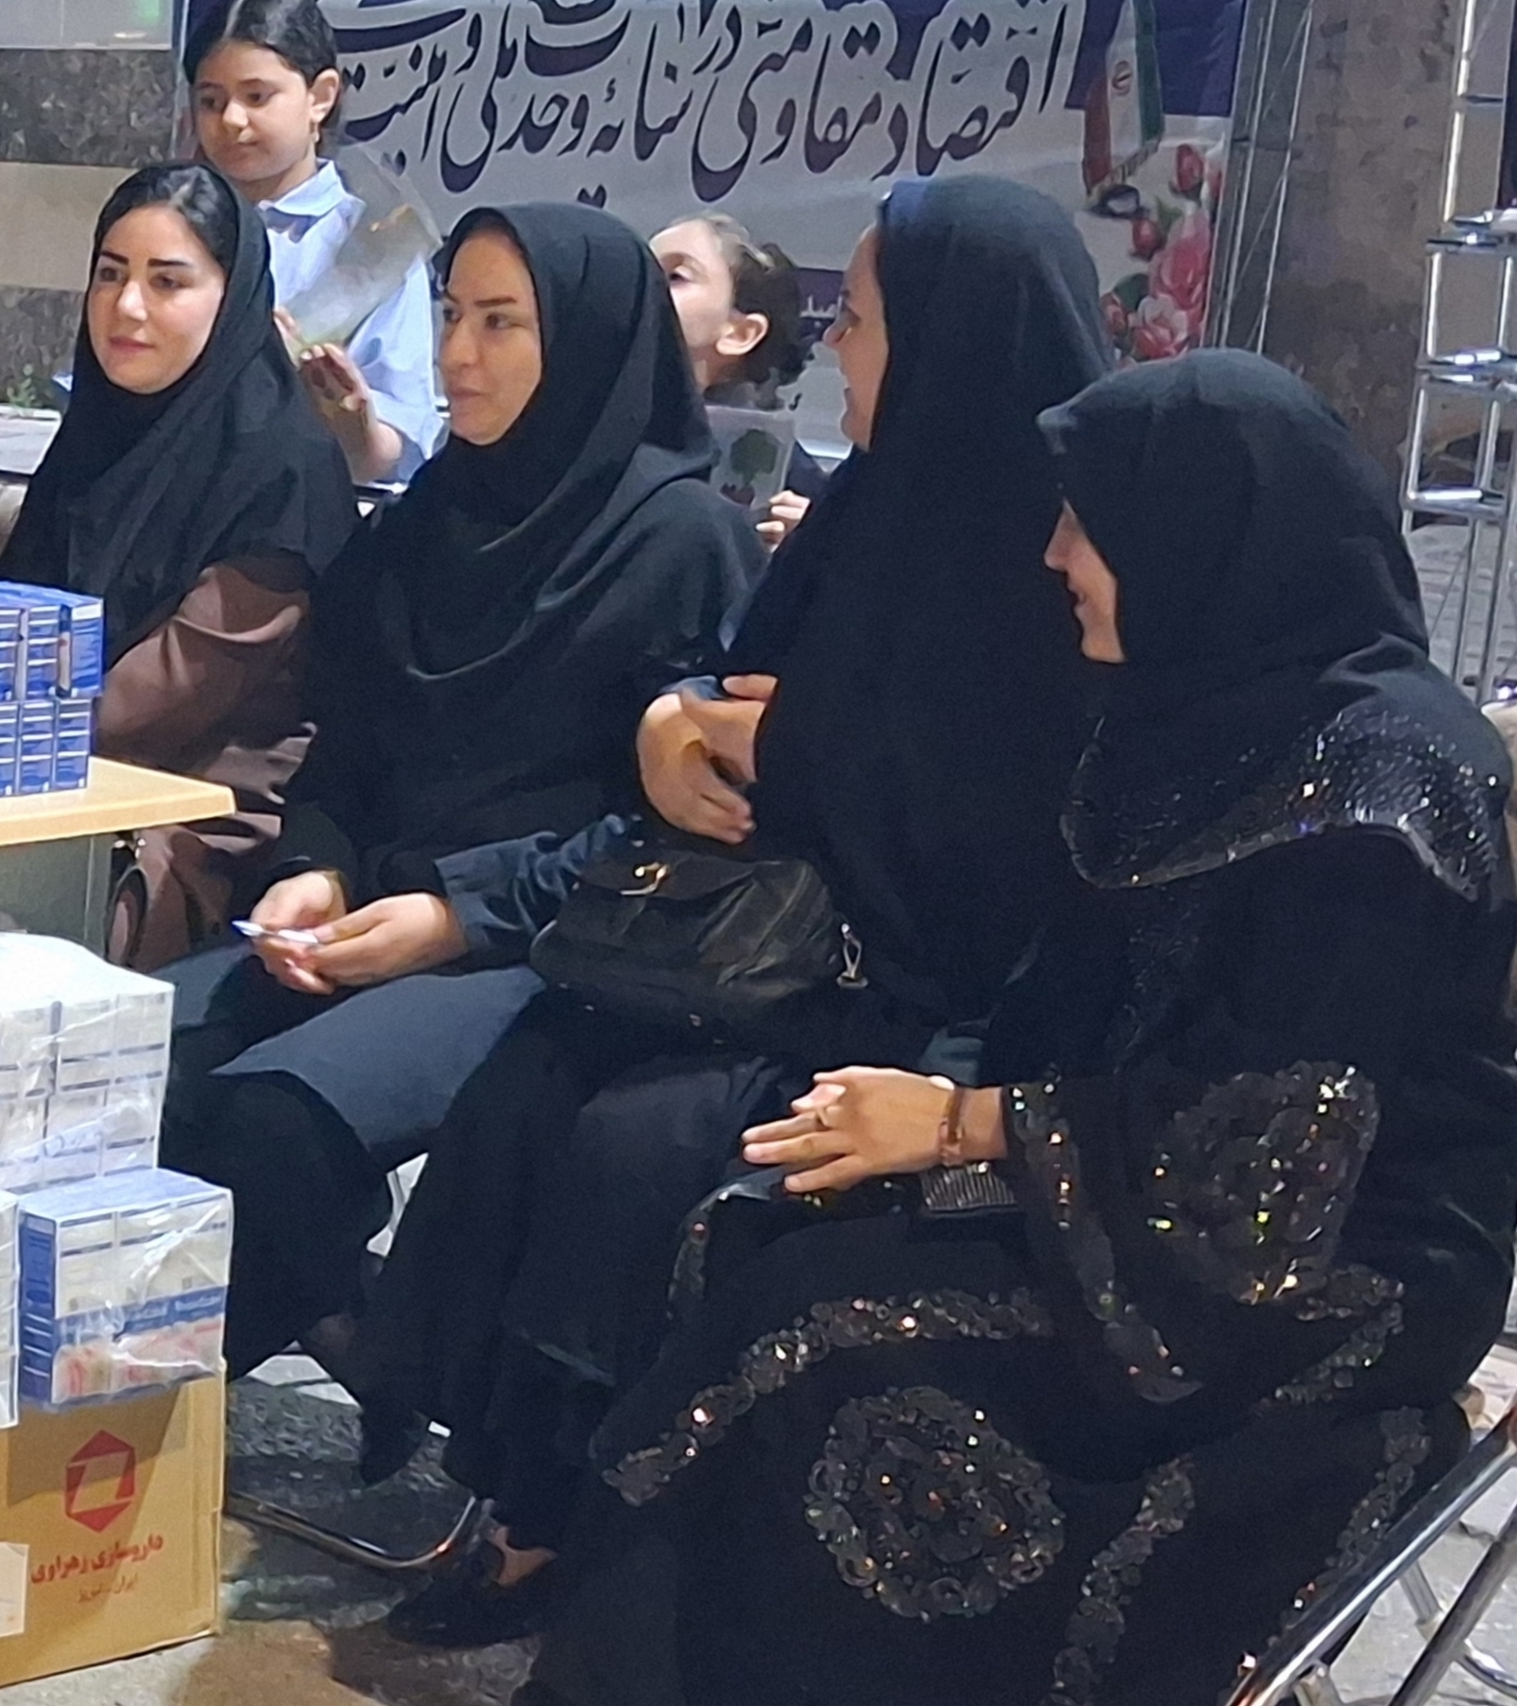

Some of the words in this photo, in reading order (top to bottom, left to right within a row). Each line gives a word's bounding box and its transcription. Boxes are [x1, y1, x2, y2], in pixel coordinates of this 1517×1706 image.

[691, 17, 881, 204] مقاومتی
[871, 0, 1068, 181] اقتصاد
[90, 1533, 164, 1570] داروسازی
